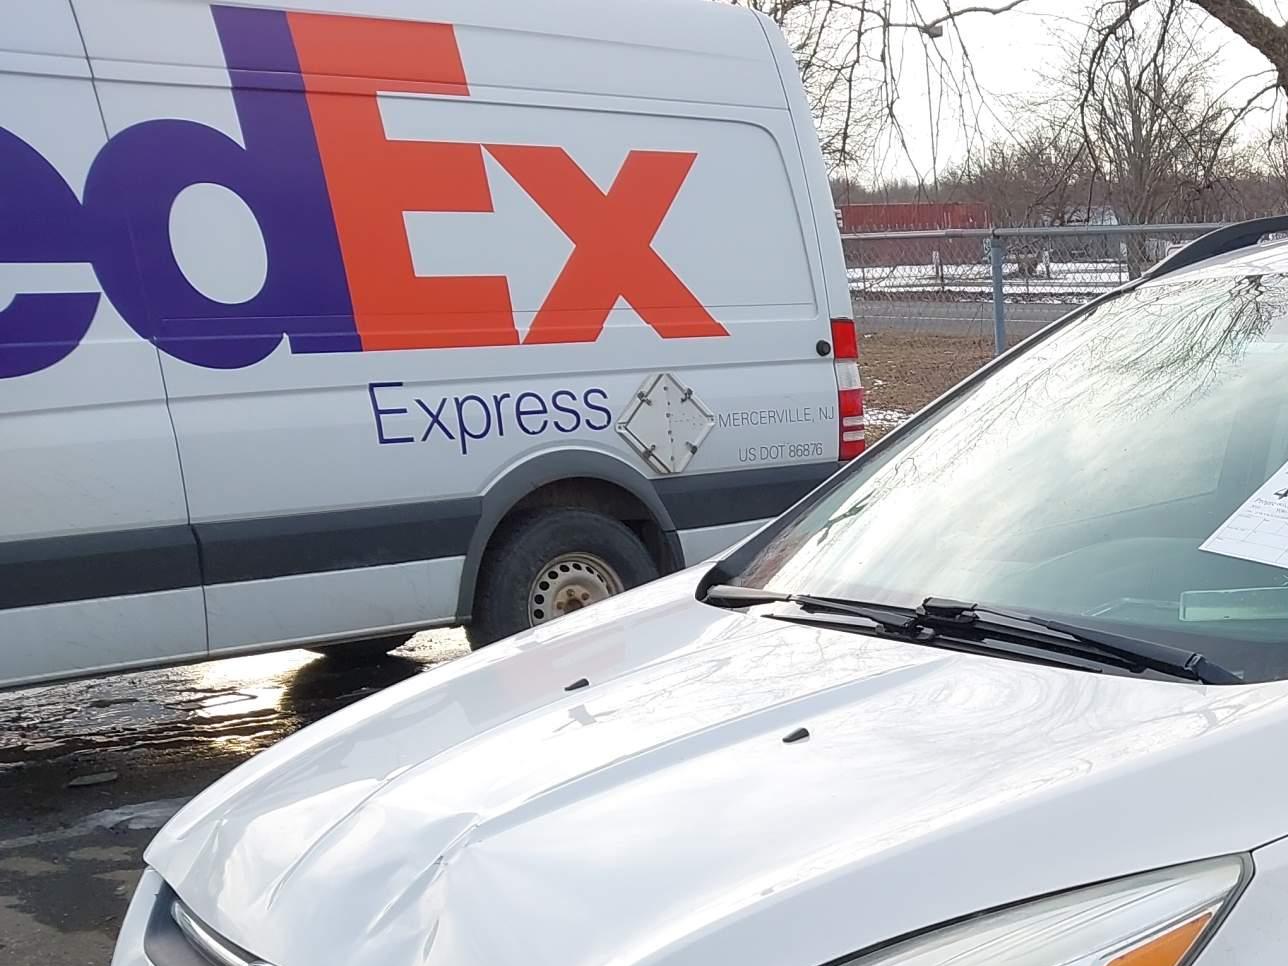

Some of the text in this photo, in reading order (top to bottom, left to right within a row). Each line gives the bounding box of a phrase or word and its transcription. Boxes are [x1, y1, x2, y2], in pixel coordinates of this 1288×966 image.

[367, 381, 612, 456] Express
[718, 406, 835, 429] MERCERVILLE, NJ
[738, 442, 823, 463] US DOT 86876
